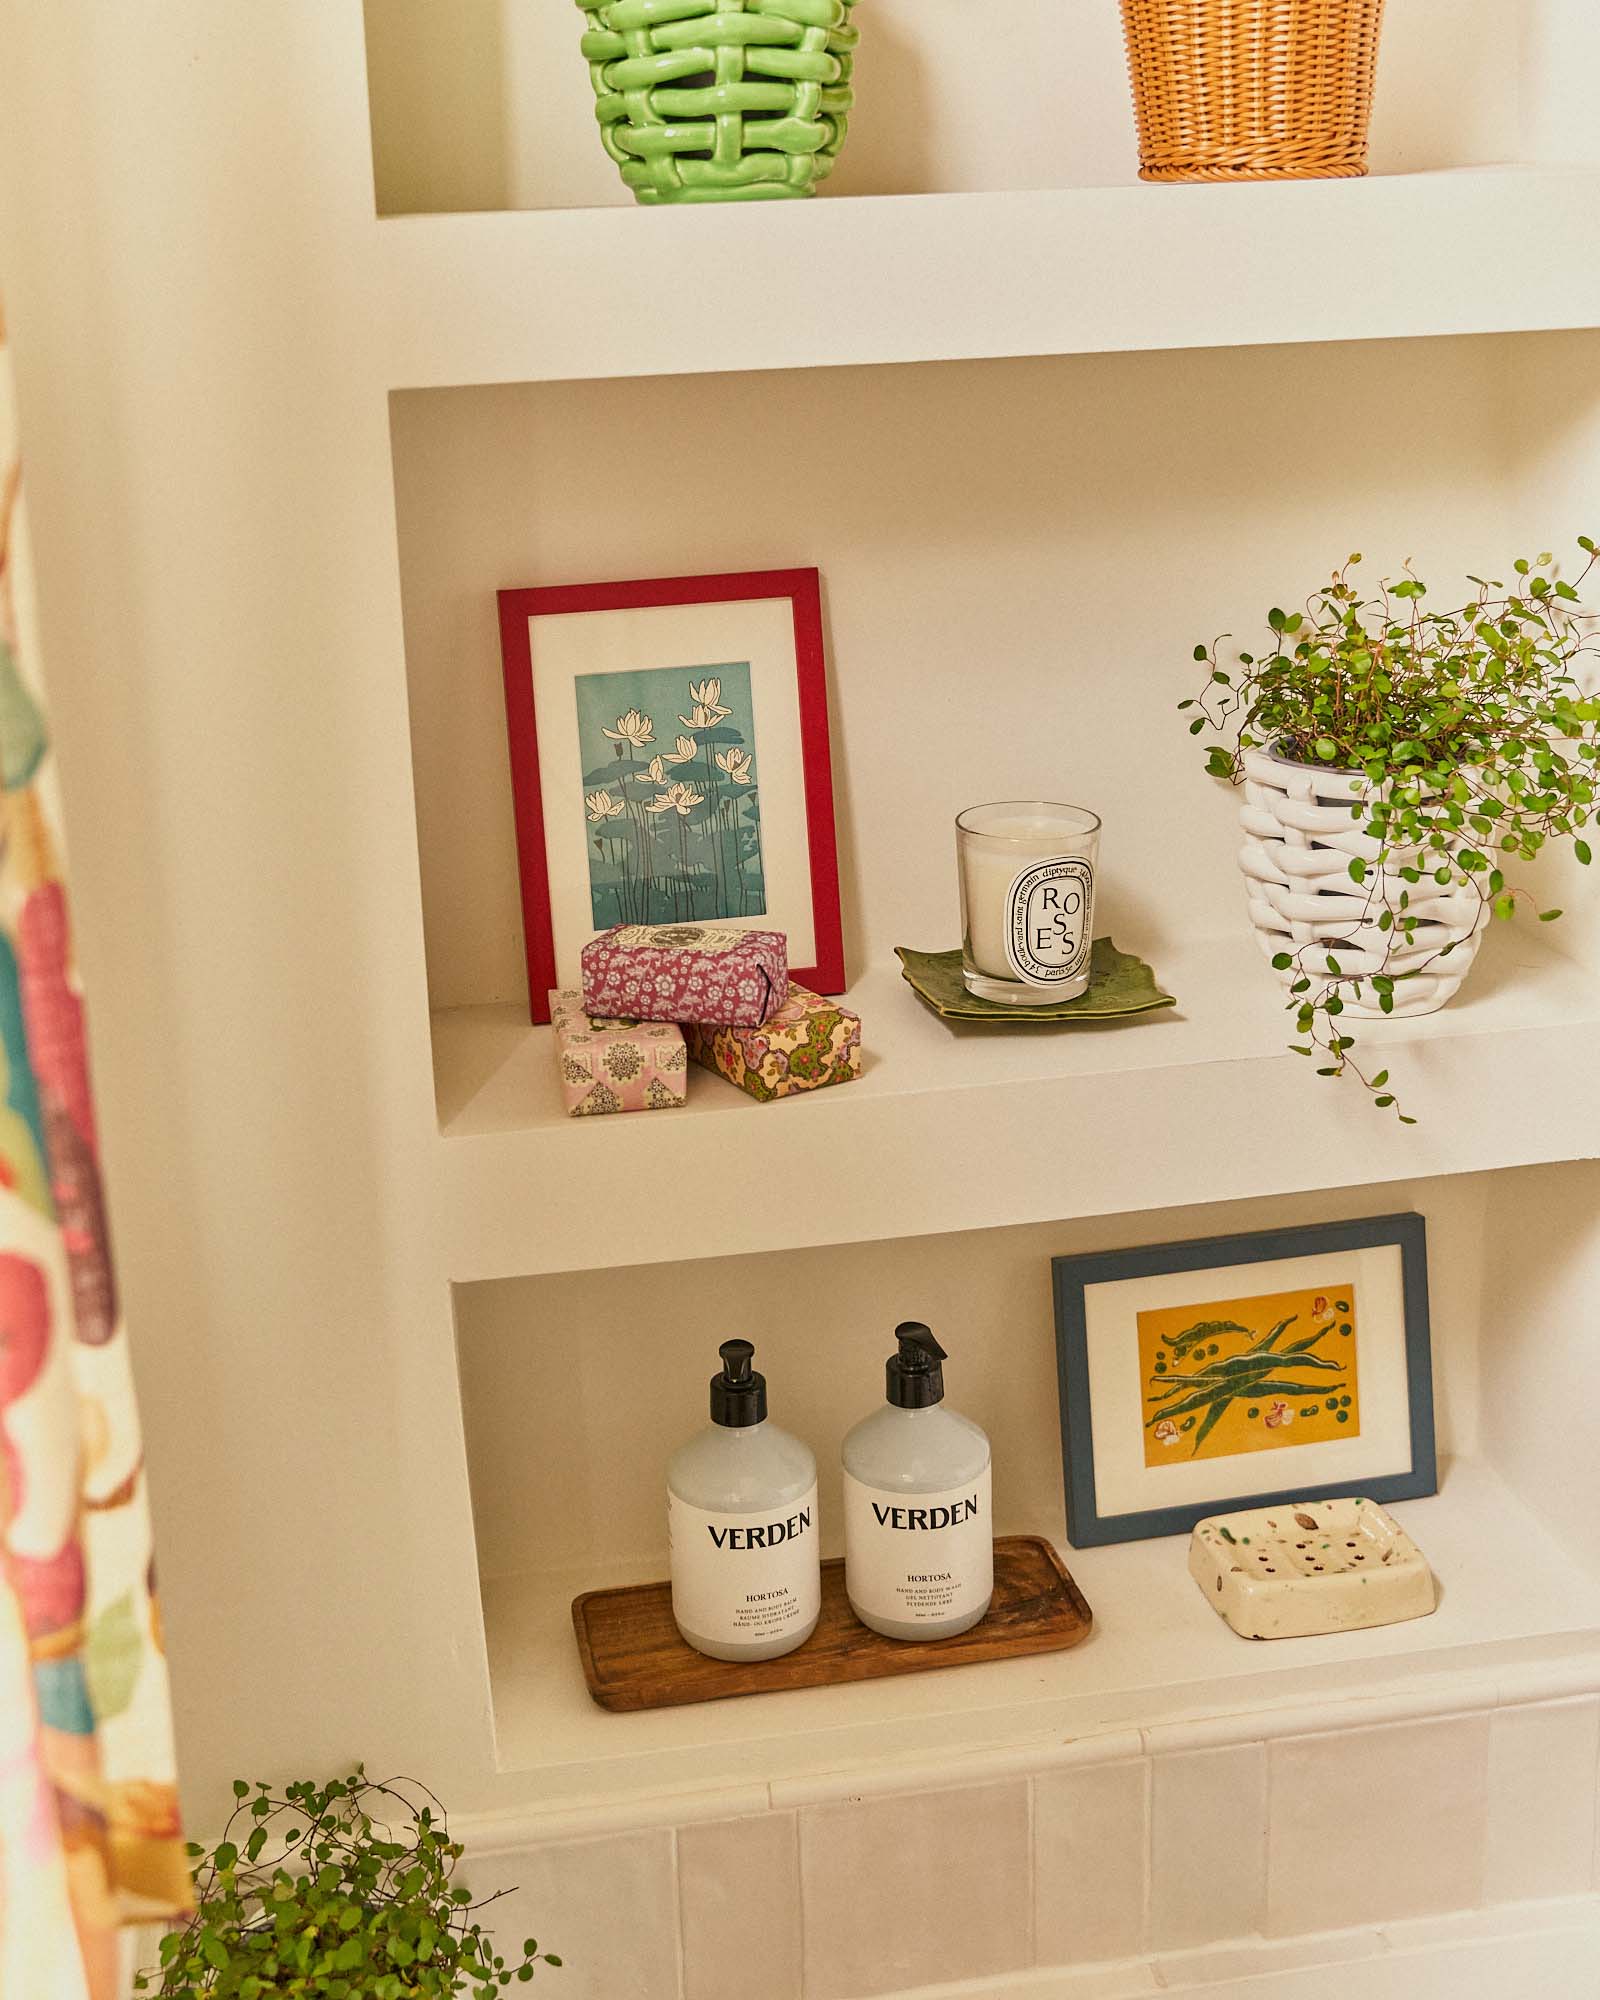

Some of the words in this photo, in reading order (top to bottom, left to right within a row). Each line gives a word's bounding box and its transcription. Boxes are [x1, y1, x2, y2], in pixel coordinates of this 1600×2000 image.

[1042, 867, 1078, 878] diptyque
[1018, 874, 1039, 905] germain
[1016, 906, 1024, 925] saint
[1015, 927, 1031, 967] boulevard
[871, 1493, 977, 1531] VERDEN
[707, 1505, 812, 1550] VERDEN
[907, 1572, 952, 1583] HORTOSA
[746, 1587, 789, 1602] HORTOSA
